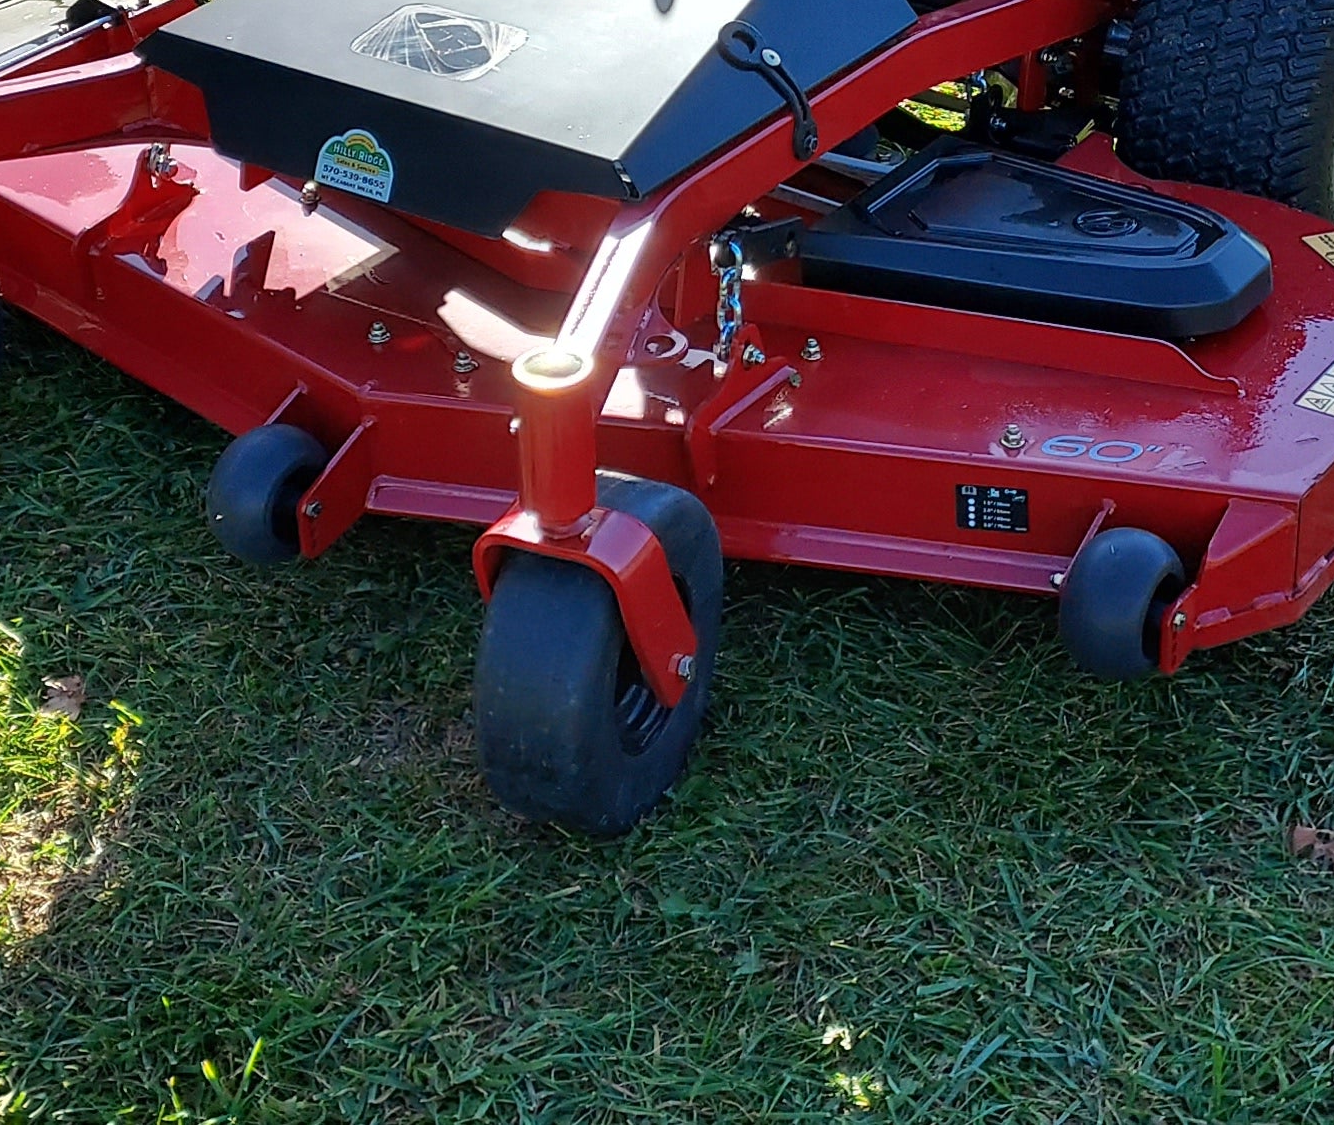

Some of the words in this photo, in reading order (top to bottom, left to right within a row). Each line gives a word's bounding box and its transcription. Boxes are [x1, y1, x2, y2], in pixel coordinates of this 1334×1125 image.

[333, 143, 357, 158] HILLY
[359, 151, 384, 166] RIDGE
[1041, 434, 1165, 463] 60"
